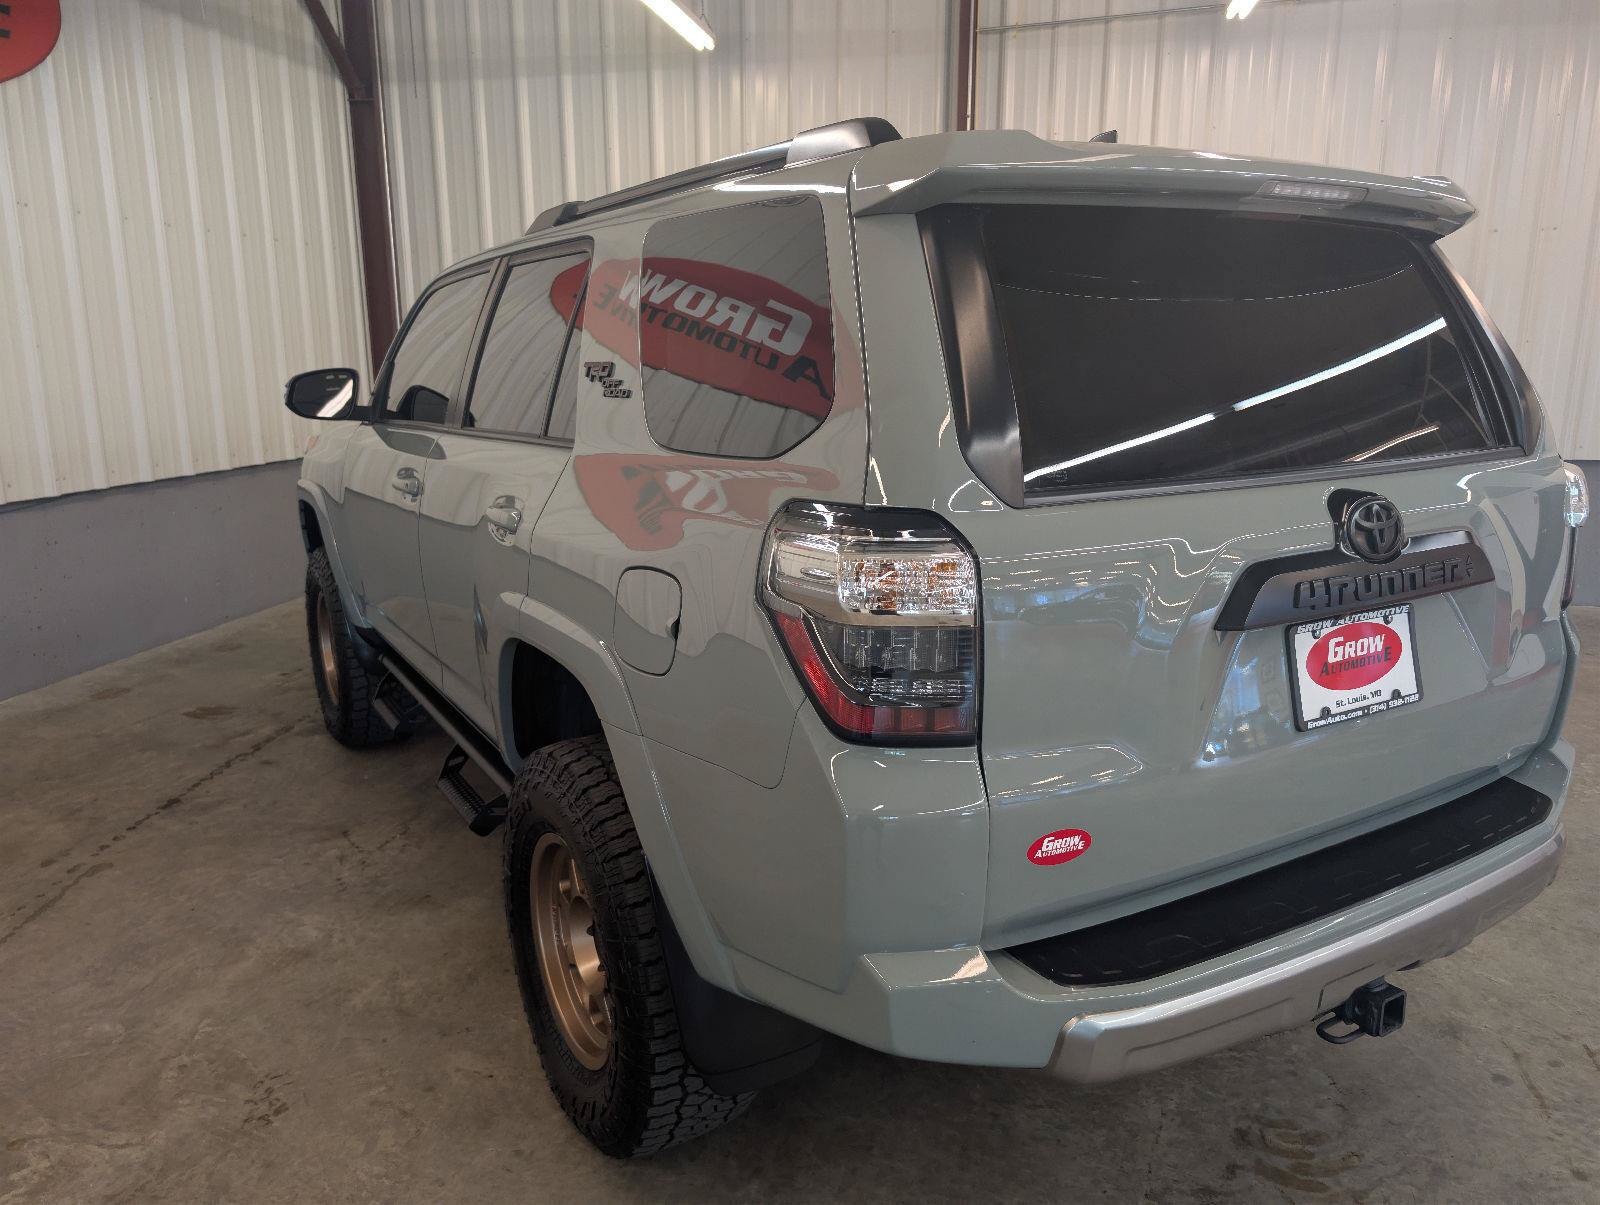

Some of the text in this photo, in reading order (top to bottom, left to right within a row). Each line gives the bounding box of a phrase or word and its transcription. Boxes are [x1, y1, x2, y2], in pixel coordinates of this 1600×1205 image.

[584, 361, 615, 383] TRD
[602, 379, 624, 389] OFF
[603, 388, 632, 399] ROAD
[1336, 605, 1410, 625] AUTOMOTIVE
[1328, 633, 1386, 663] GROW
[1320, 646, 1393, 677] AUTOMOTIVE
[1034, 840, 1086, 859] AUTOMOTIVE
[1041, 834, 1082, 852] GROW
